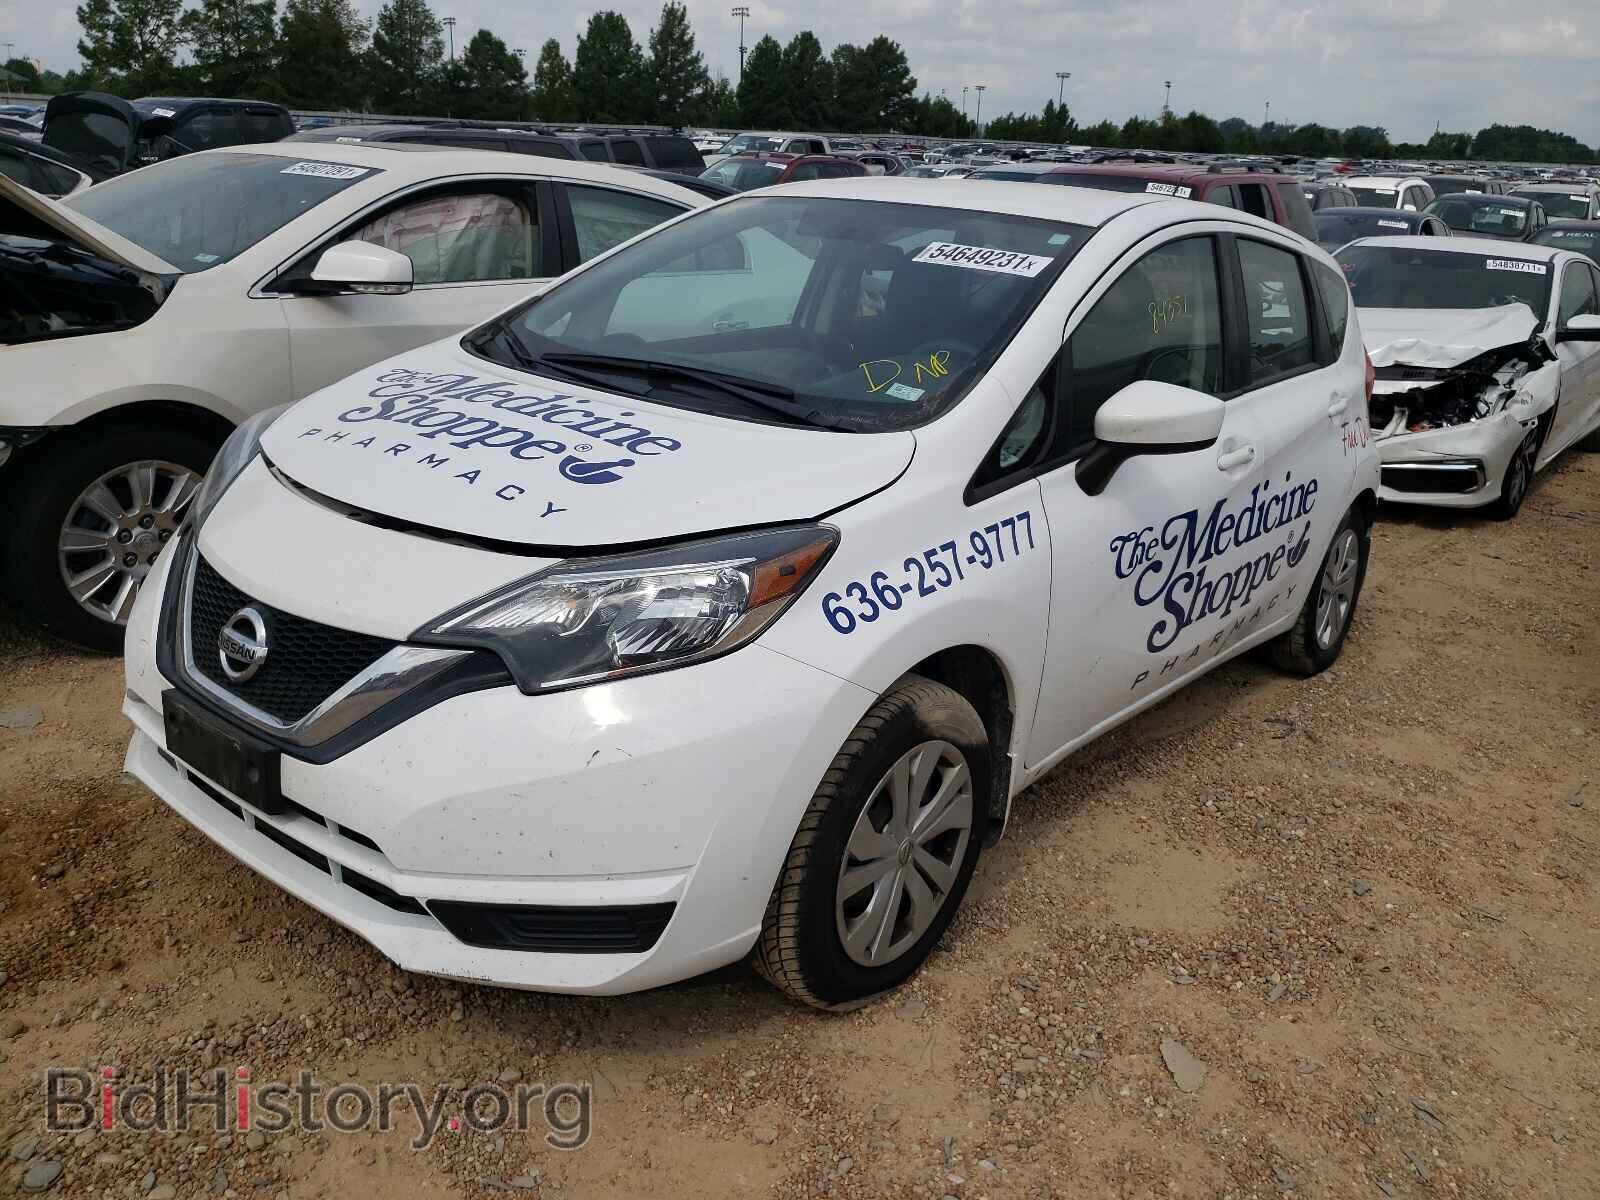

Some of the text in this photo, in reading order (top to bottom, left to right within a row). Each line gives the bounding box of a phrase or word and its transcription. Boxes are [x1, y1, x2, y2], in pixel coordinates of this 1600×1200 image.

[368, 368, 683, 456] The Medicine
[858, 359, 902, 393] D
[297, 427, 568, 518] PHARMACY
[337, 394, 563, 460] Shoppe
[821, 510, 1035, 635] 636-257-9777
[1109, 471, 1318, 607] The Medicine
[1130, 584, 1297, 690] PHARMACY
[1146, 545, 1285, 653] Shoppe
